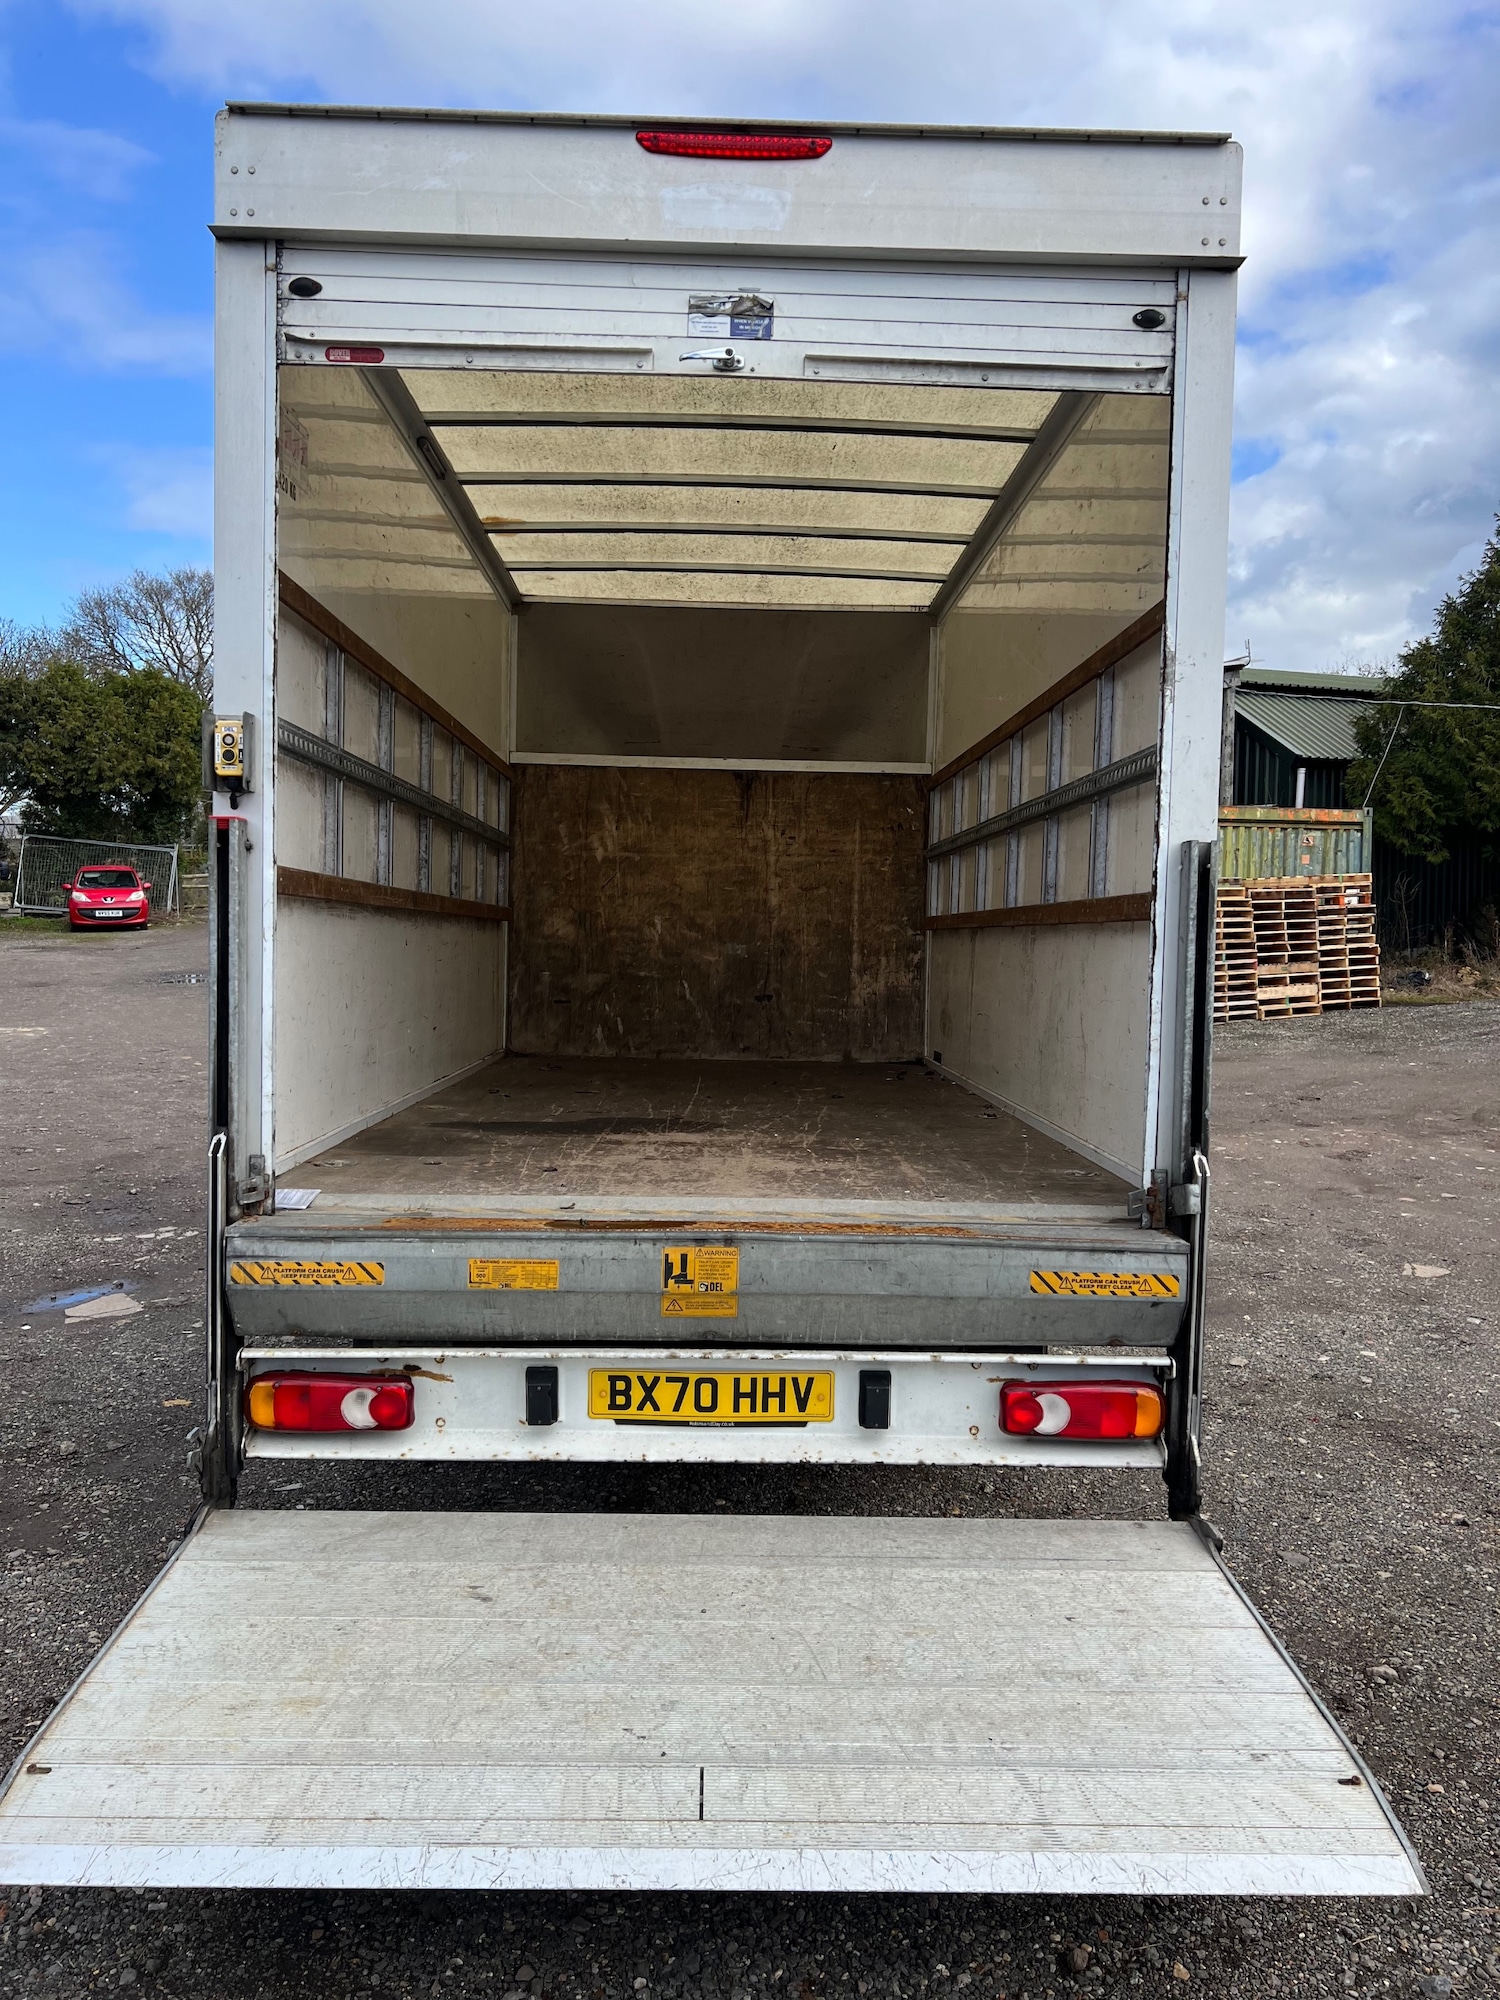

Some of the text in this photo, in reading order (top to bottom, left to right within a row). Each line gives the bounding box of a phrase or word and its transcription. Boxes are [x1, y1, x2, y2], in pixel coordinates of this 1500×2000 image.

[710, 1282, 724, 1291] DEL
[608, 1375, 814, 1413] BX70 HHV
